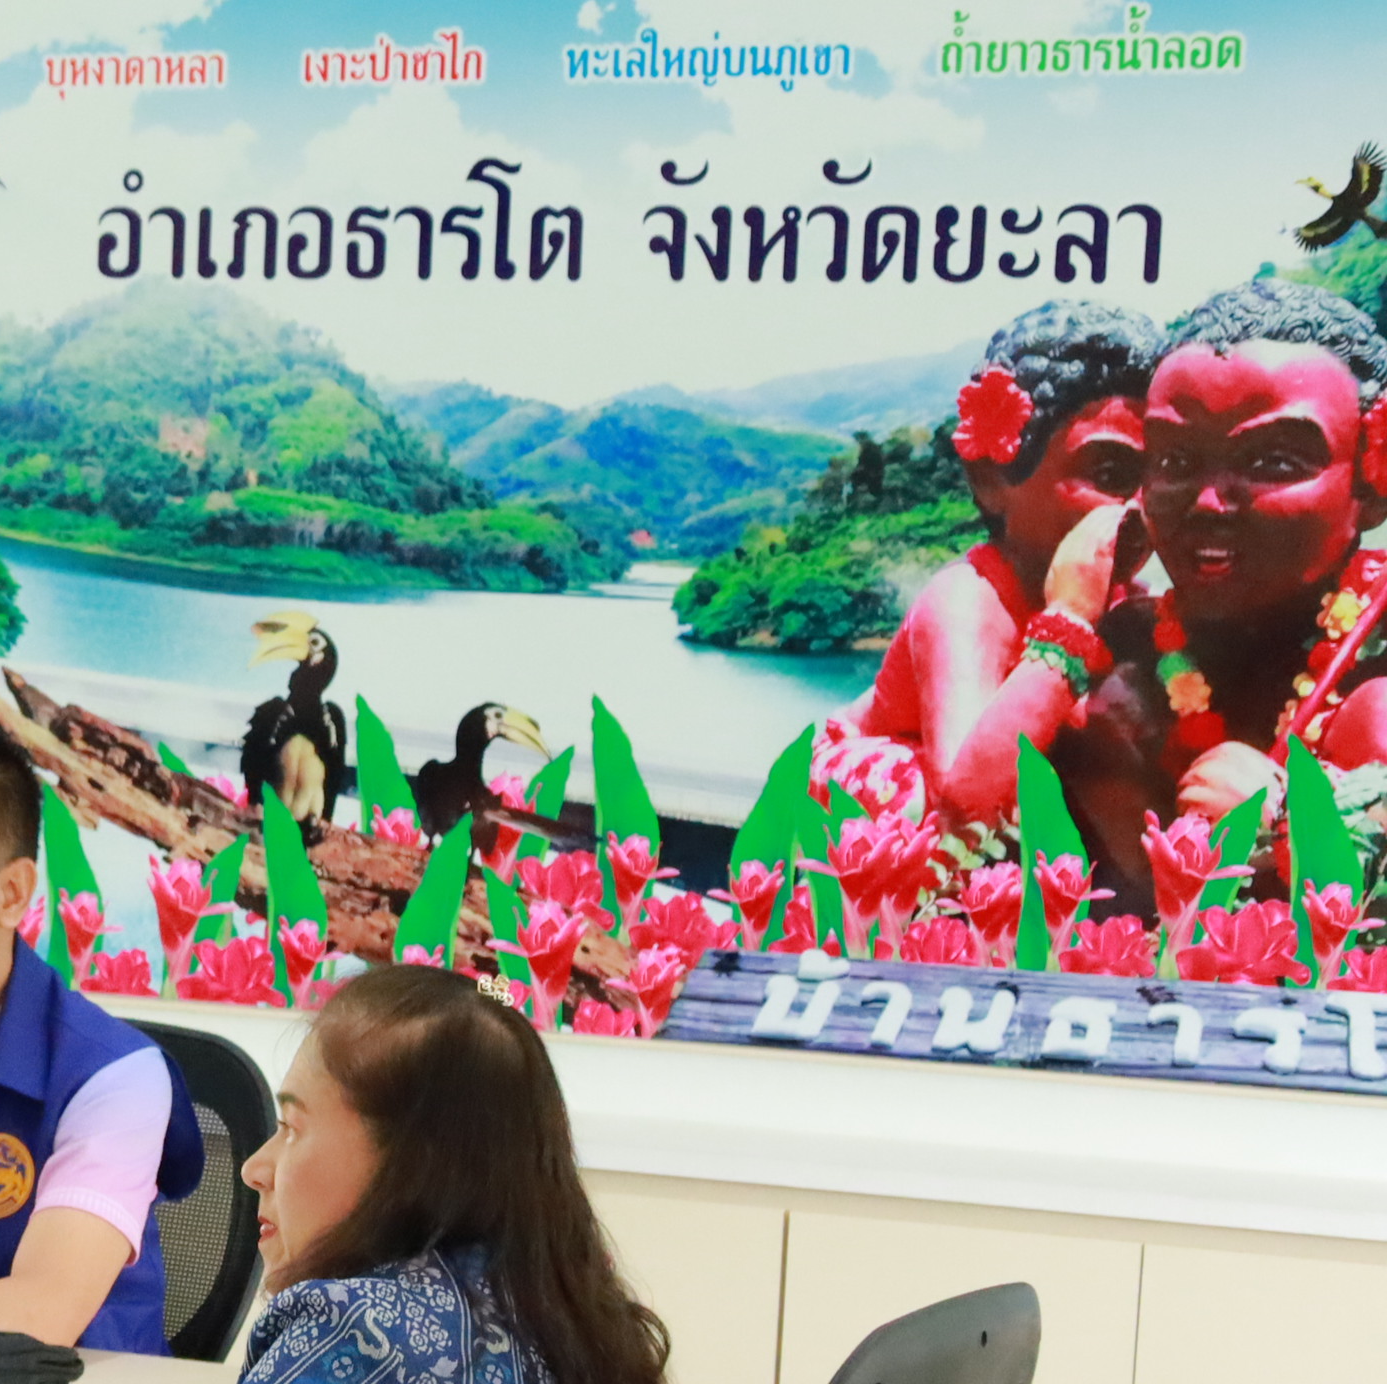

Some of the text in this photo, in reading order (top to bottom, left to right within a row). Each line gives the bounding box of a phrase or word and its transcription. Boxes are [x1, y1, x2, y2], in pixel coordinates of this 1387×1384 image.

[45, 54, 225, 99] บุหงาดาหลา
[565, 30, 852, 92] ทะเลใหญ่บนภูเขา
[940, 9, 1243, 75] ถ้ำยาวธารน้ำลอด
[96, 157, 1164, 284] อำเภอธารโต จังหวัดยะลา
